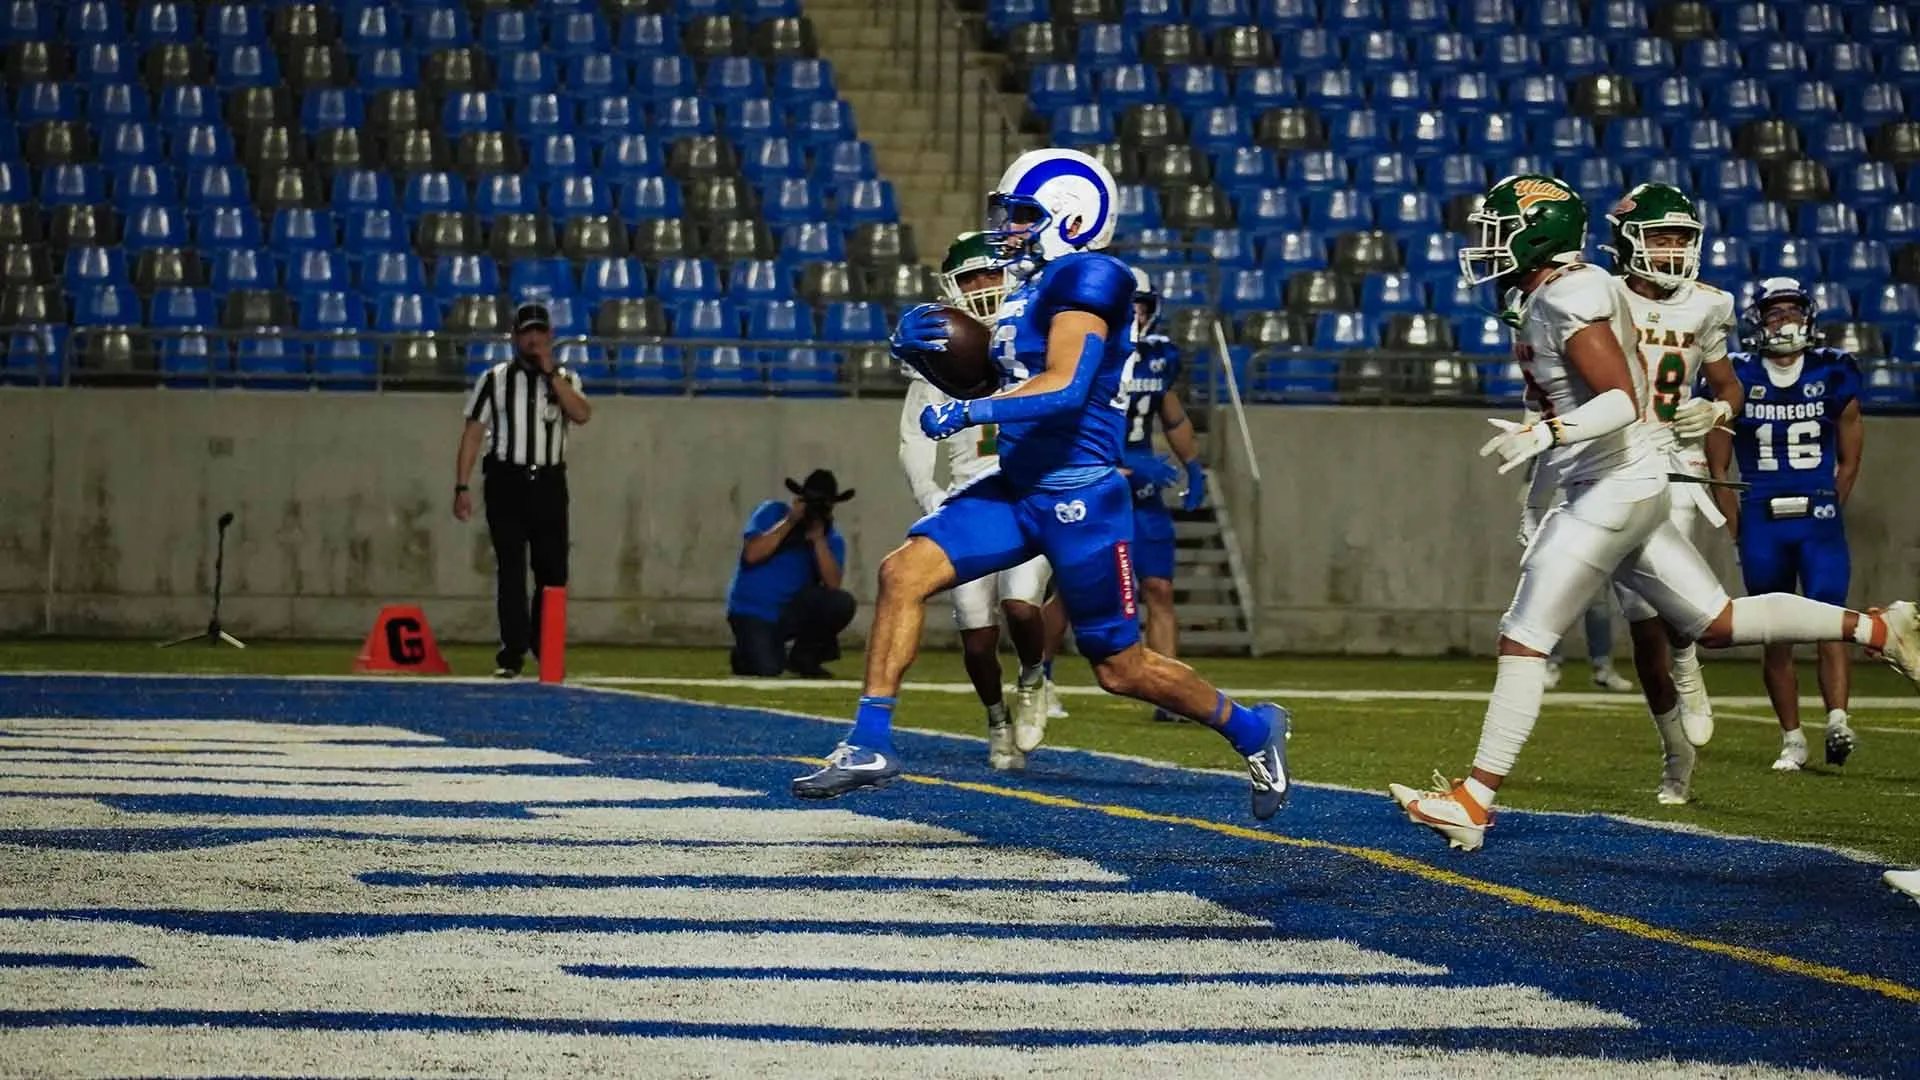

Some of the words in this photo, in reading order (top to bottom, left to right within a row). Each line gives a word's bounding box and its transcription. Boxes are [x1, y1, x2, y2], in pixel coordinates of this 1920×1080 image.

[1744, 401, 1825, 420] BORREGOS
[1755, 420, 1822, 471] 16
[385, 617, 426, 665] G
